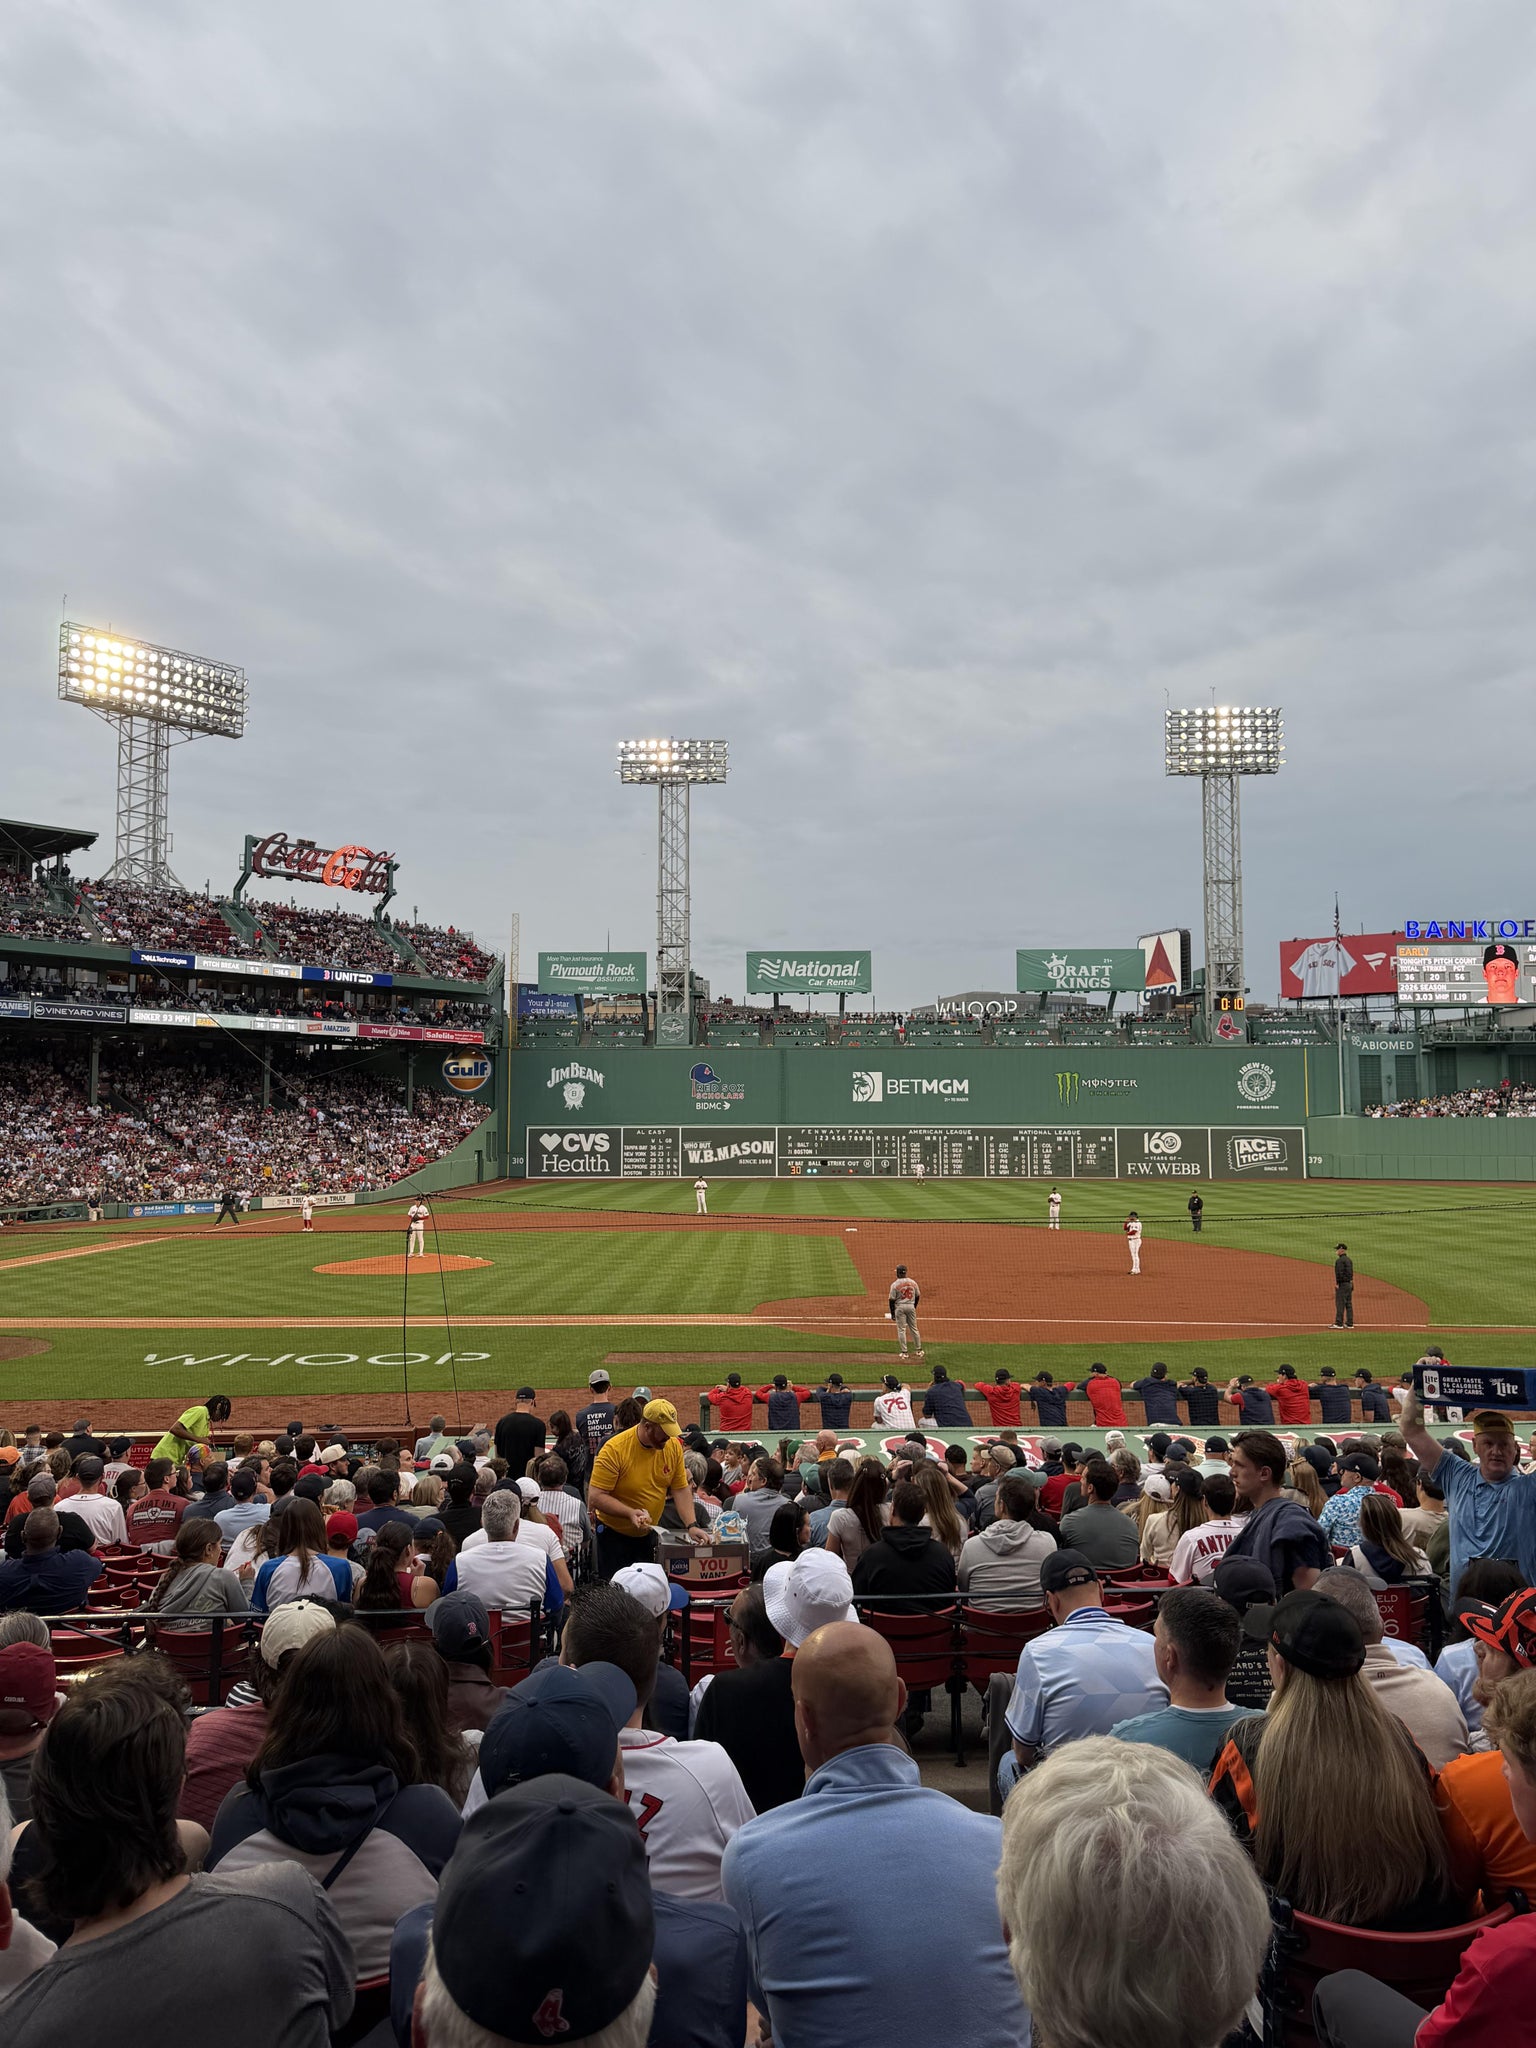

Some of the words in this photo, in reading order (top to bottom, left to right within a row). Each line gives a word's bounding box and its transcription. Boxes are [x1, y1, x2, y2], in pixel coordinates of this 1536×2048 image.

[253, 833, 395, 893] Coca-Cola
[1405, 920, 1488, 938] BANK
[1499, 919, 1536, 938] OF
[1399, 947, 1429, 956] EARLY
[202, 960, 221, 969] PITCH
[222, 961, 240, 970] BREAK
[550, 964, 604, 976] Plymouth
[606, 964, 635, 976] Rock
[781, 960, 859, 976] National
[1048, 964, 1112, 979] DRAFT
[335, 971, 374, 984] UNITED
[1056, 976, 1111, 988] KINGS
[936, 1000, 1018, 1016] WHOOP
[1221, 998, 1244, 1010] 0:10
[45, 1007, 94, 1017] VINEYARD
[97, 1010, 123, 1019] VINES
[134, 1012, 160, 1022] SINKER
[162, 1014, 174, 1022] 93
[175, 1014, 190, 1023] MPH
[426, 1032, 454, 1040] Safelite
[1362, 1041, 1414, 1050] ABIOMED
[444, 1062, 488, 1076] Gulf
[547, 1067, 570, 1088] JIM
[570, 1062, 605, 1088] BEAM
[1239, 1062, 1260, 1074] IBEW
[1260, 1064, 1274, 1075] 103
[887, 1079, 968, 1094] BETMGM
[562, 1133, 610, 1152] CVS
[1143, 1132, 1182, 1154] 160
[1239, 1138, 1280, 1154] ACE
[688, 1140, 774, 1163] W.B.MASON
[1240, 1152, 1280, 1164] TICKET
[542, 1154, 610, 1172] Health
[1127, 1163, 1159, 1175] F.W.
[1161, 1163, 1201, 1175] WEBB
[791, 1166, 801, 1174] 30
[144, 1353, 491, 1366] WHOOP
[1424, 1376, 1438, 1384] Lite
[1496, 1379, 1518, 1397] Lite
[884, 1397, 908, 1413] 76
[135, 1500, 160, 1511] ARIAT
[1197, 1534, 1232, 1557] ANTH
[699, 1560, 728, 1571] YOU
[1380, 1605, 1394, 1613] OX
